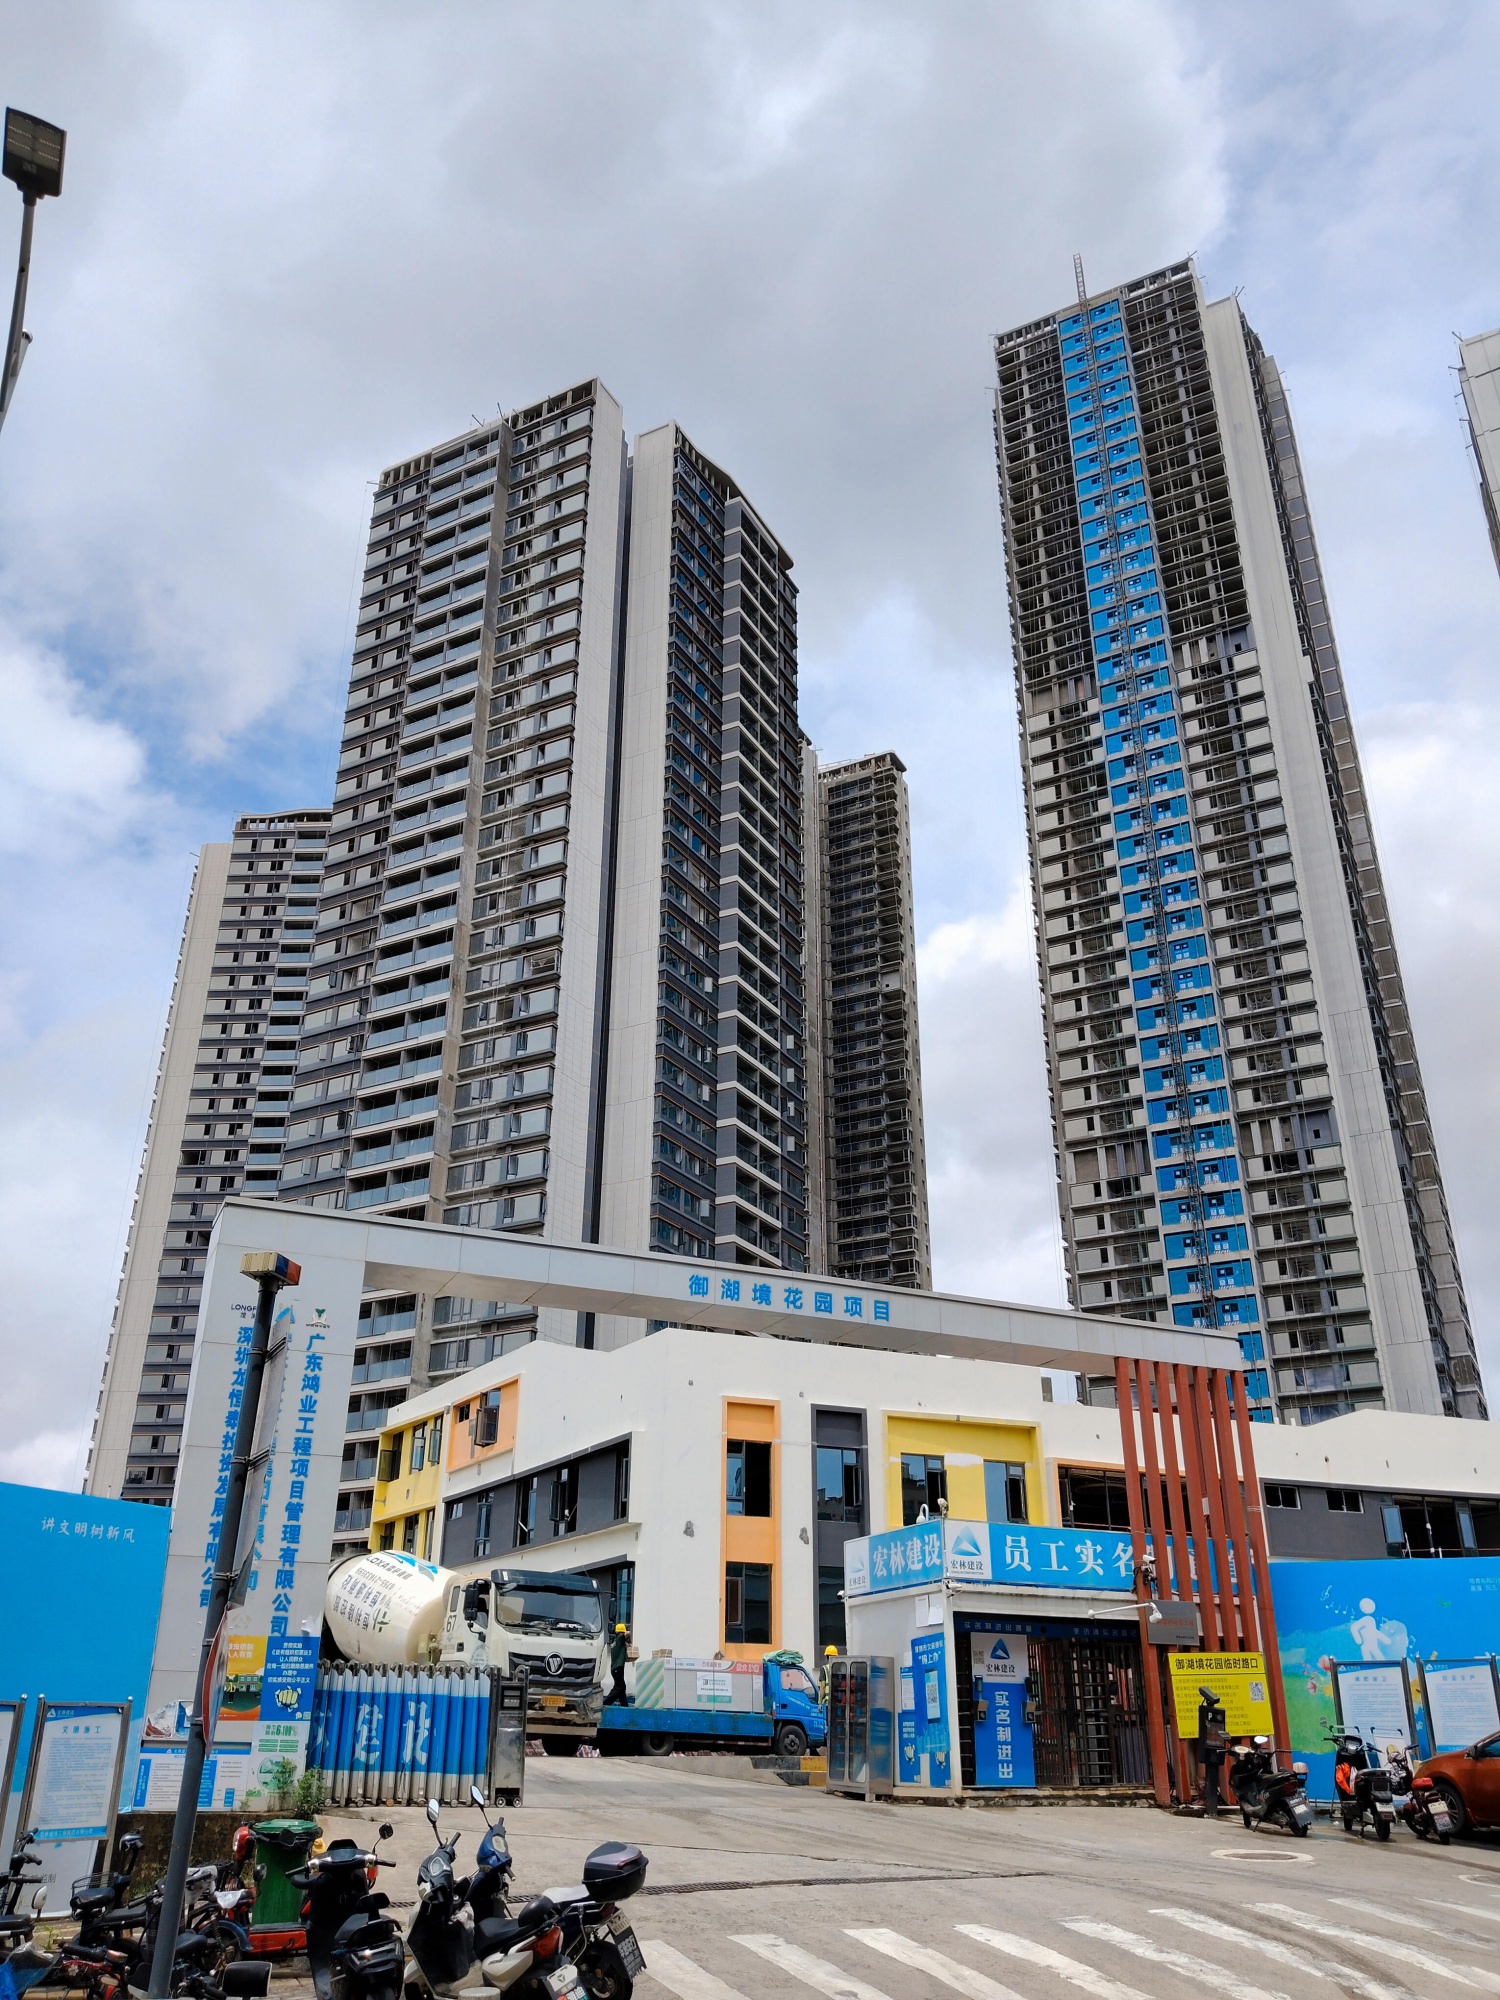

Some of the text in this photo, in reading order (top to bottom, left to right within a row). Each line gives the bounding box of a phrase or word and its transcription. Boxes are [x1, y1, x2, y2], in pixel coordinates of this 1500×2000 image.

[689, 1274, 890, 1321] 御湖境花园项目
[270, 1333, 326, 1637] 广东鸿业工程项目管理有限公司
[41, 1517, 135, 1543] 讲文明树新风
[872, 1533, 941, 1578] 宏林建设
[950, 1559, 983, 1571] 宏林建设
[446, 1614, 457, 1633] 67
[964, 1621, 1032, 1633] 实名制进出通道
[985, 1663, 1015, 1673] 宏林建设
[1175, 1658, 1258, 1670] 御湖境花园临时路口
[62, 1725, 101, 1734] 文明施工
[994, 1690, 1013, 1779] 实名制进出
